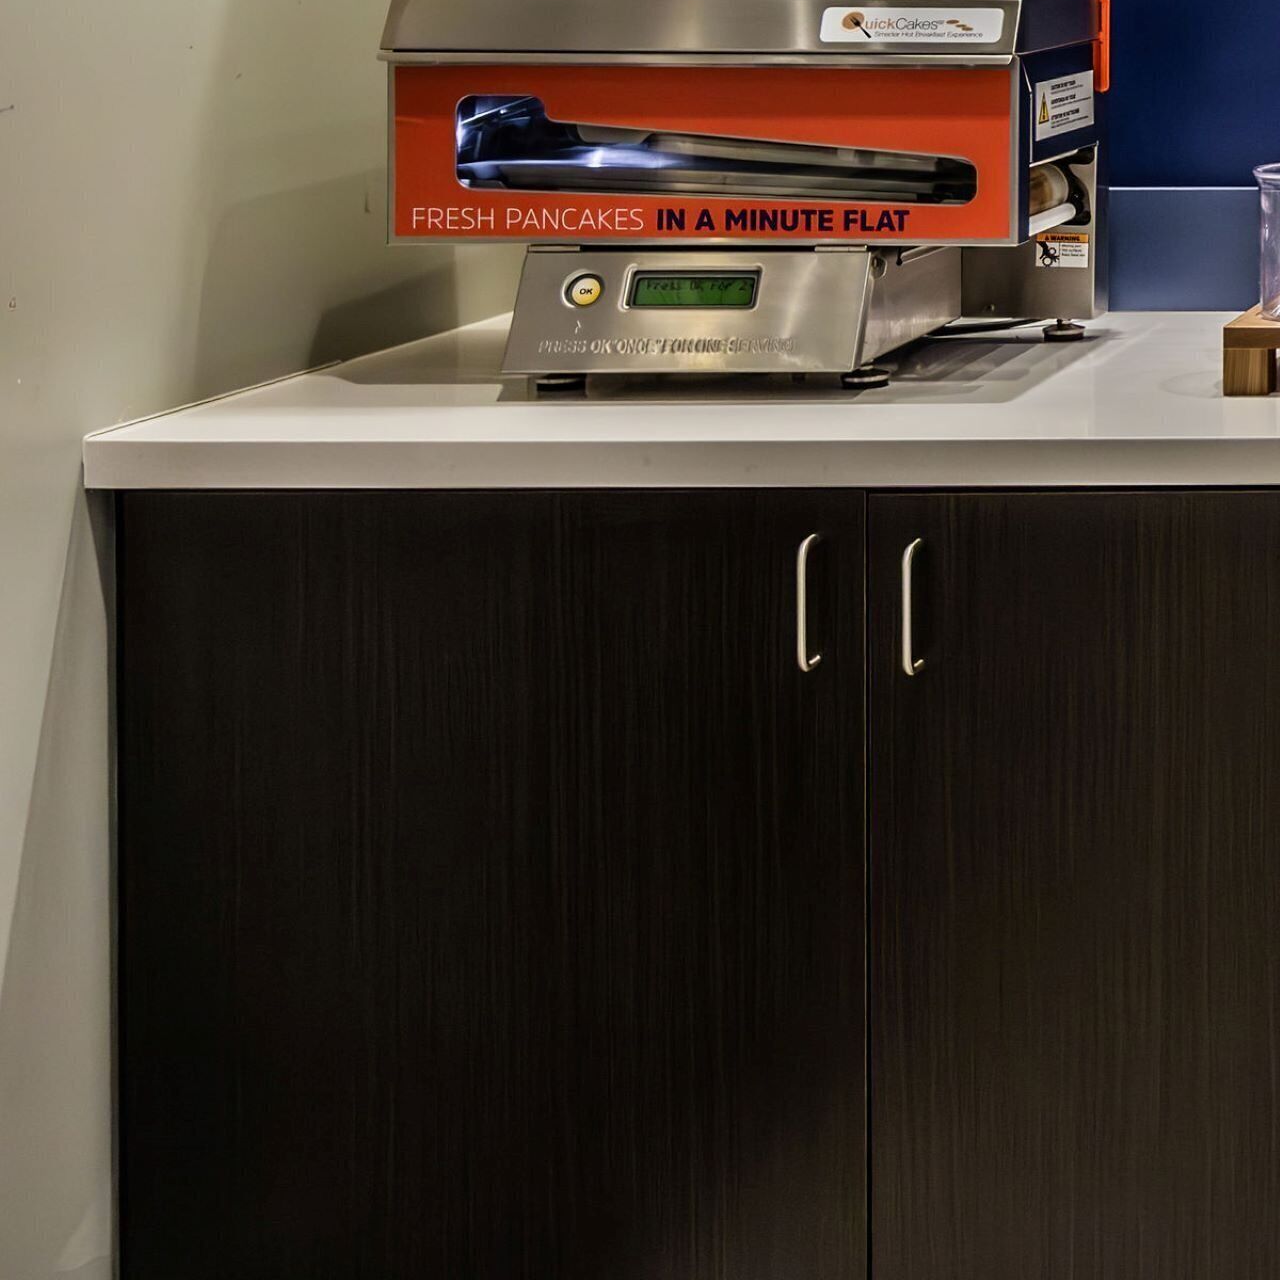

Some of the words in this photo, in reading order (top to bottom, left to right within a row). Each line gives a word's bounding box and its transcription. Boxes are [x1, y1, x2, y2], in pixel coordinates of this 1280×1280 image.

[411, 207, 495, 231] FRESH
[506, 207, 644, 231] PANCAKES
[657, 208, 685, 232] IN
[695, 209, 715, 231] A
[725, 209, 834, 232] MINUTE
[843, 208, 910, 232] FLAT
[579, 287, 593, 296] OK
[589, 338, 612, 354] OK
